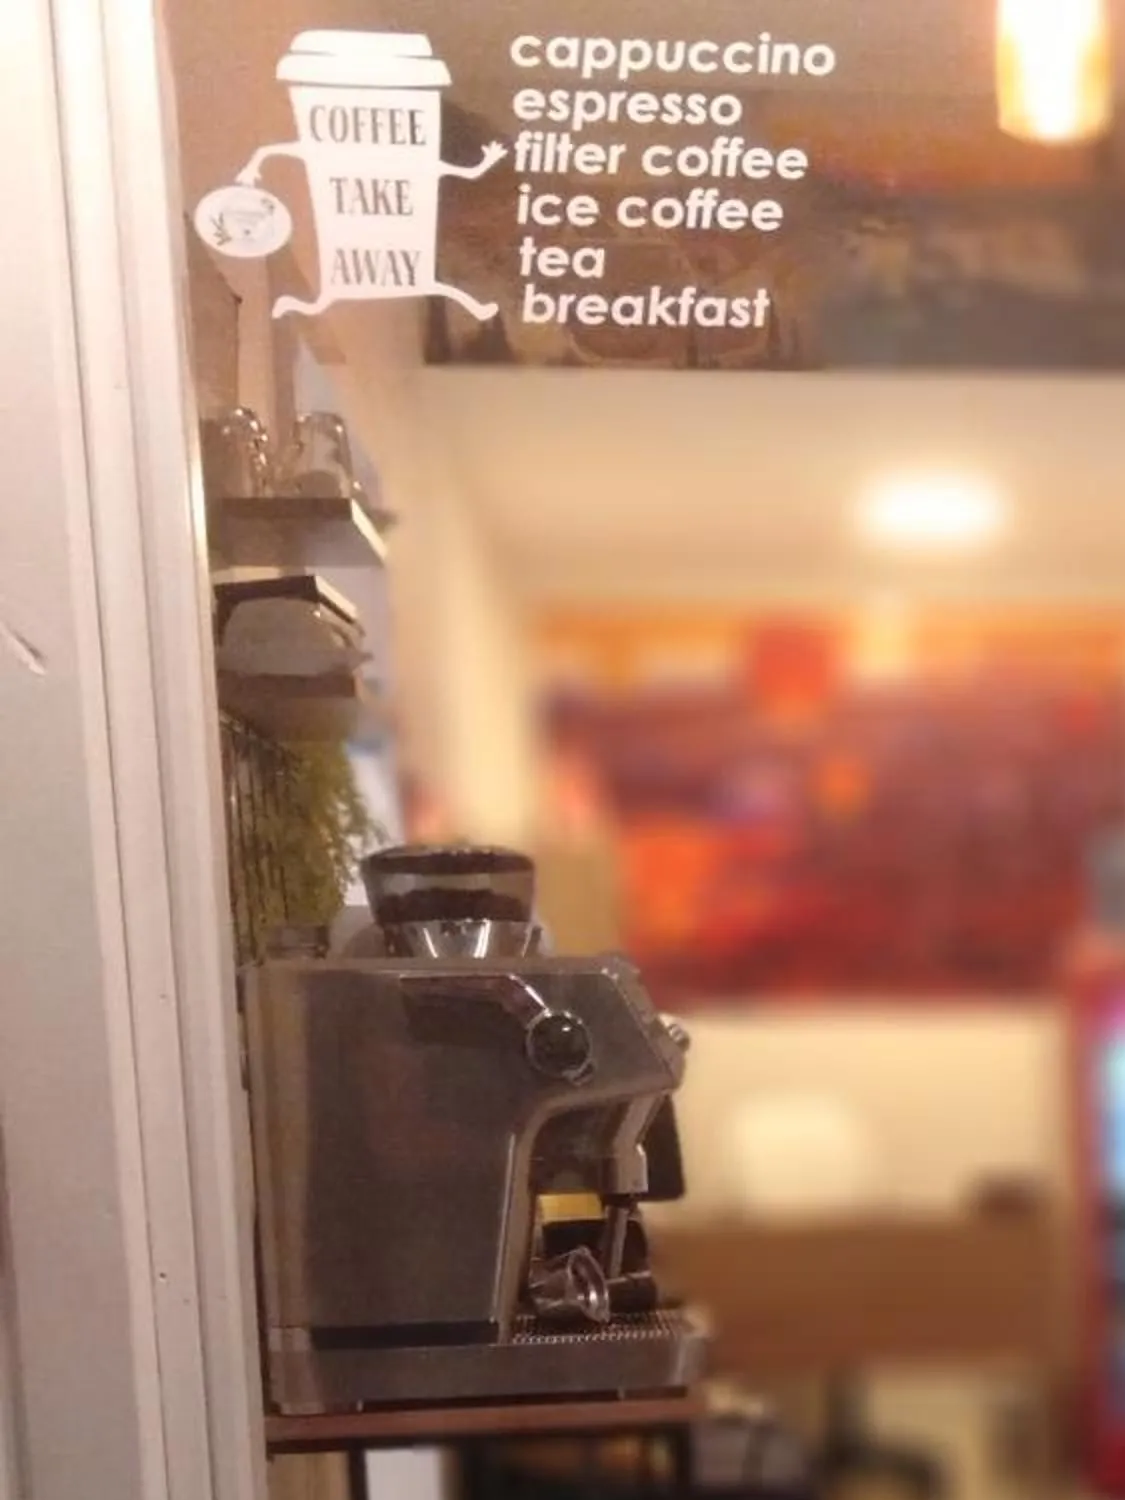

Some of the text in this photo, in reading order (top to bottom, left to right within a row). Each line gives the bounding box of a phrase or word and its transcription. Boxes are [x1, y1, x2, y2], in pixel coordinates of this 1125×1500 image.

[510, 33, 835, 77] cappuccino
[309, 105, 426, 147] COFFEE
[512, 87, 742, 128] espresso
[514, 132, 808, 180] filter coffee
[330, 177, 414, 217] TAKE
[516, 184, 783, 232] ice coffee
[330, 246, 422, 288] AWAY
[519, 236, 605, 279] tea
[522, 284, 769, 328] breakfast
